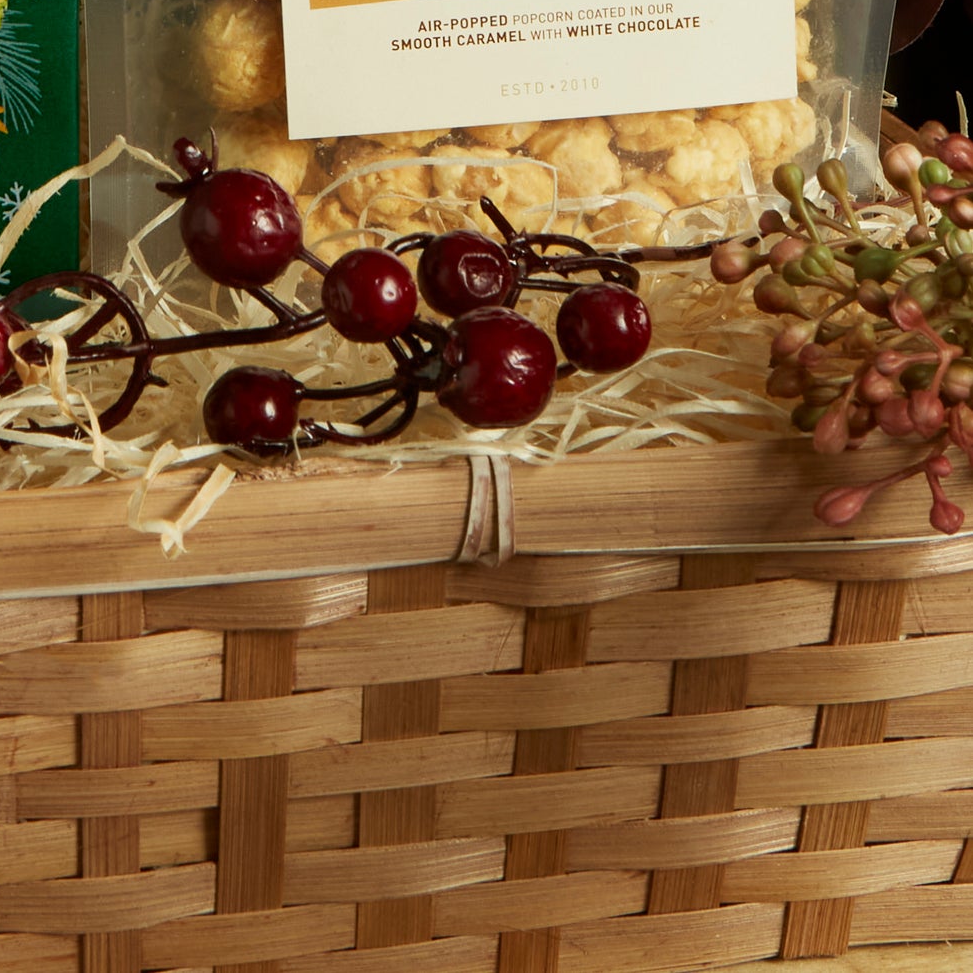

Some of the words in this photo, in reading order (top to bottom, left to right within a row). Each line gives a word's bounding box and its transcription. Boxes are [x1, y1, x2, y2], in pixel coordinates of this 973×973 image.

[417, 14, 508, 32] AIR-POPPED
[512, 10, 574, 25] POPCORN
[577, 7, 626, 20] COATED
[630, 6, 643, 16] IN
[647, 3, 673, 15] OUR
[391, 35, 452, 52] SMOOTH
[456, 30, 526, 46] CARAMEL
[530, 28, 562, 40] WITH
[566, 22, 613, 37] WHITE
[617, 16, 701, 34] CHOCOLATE
